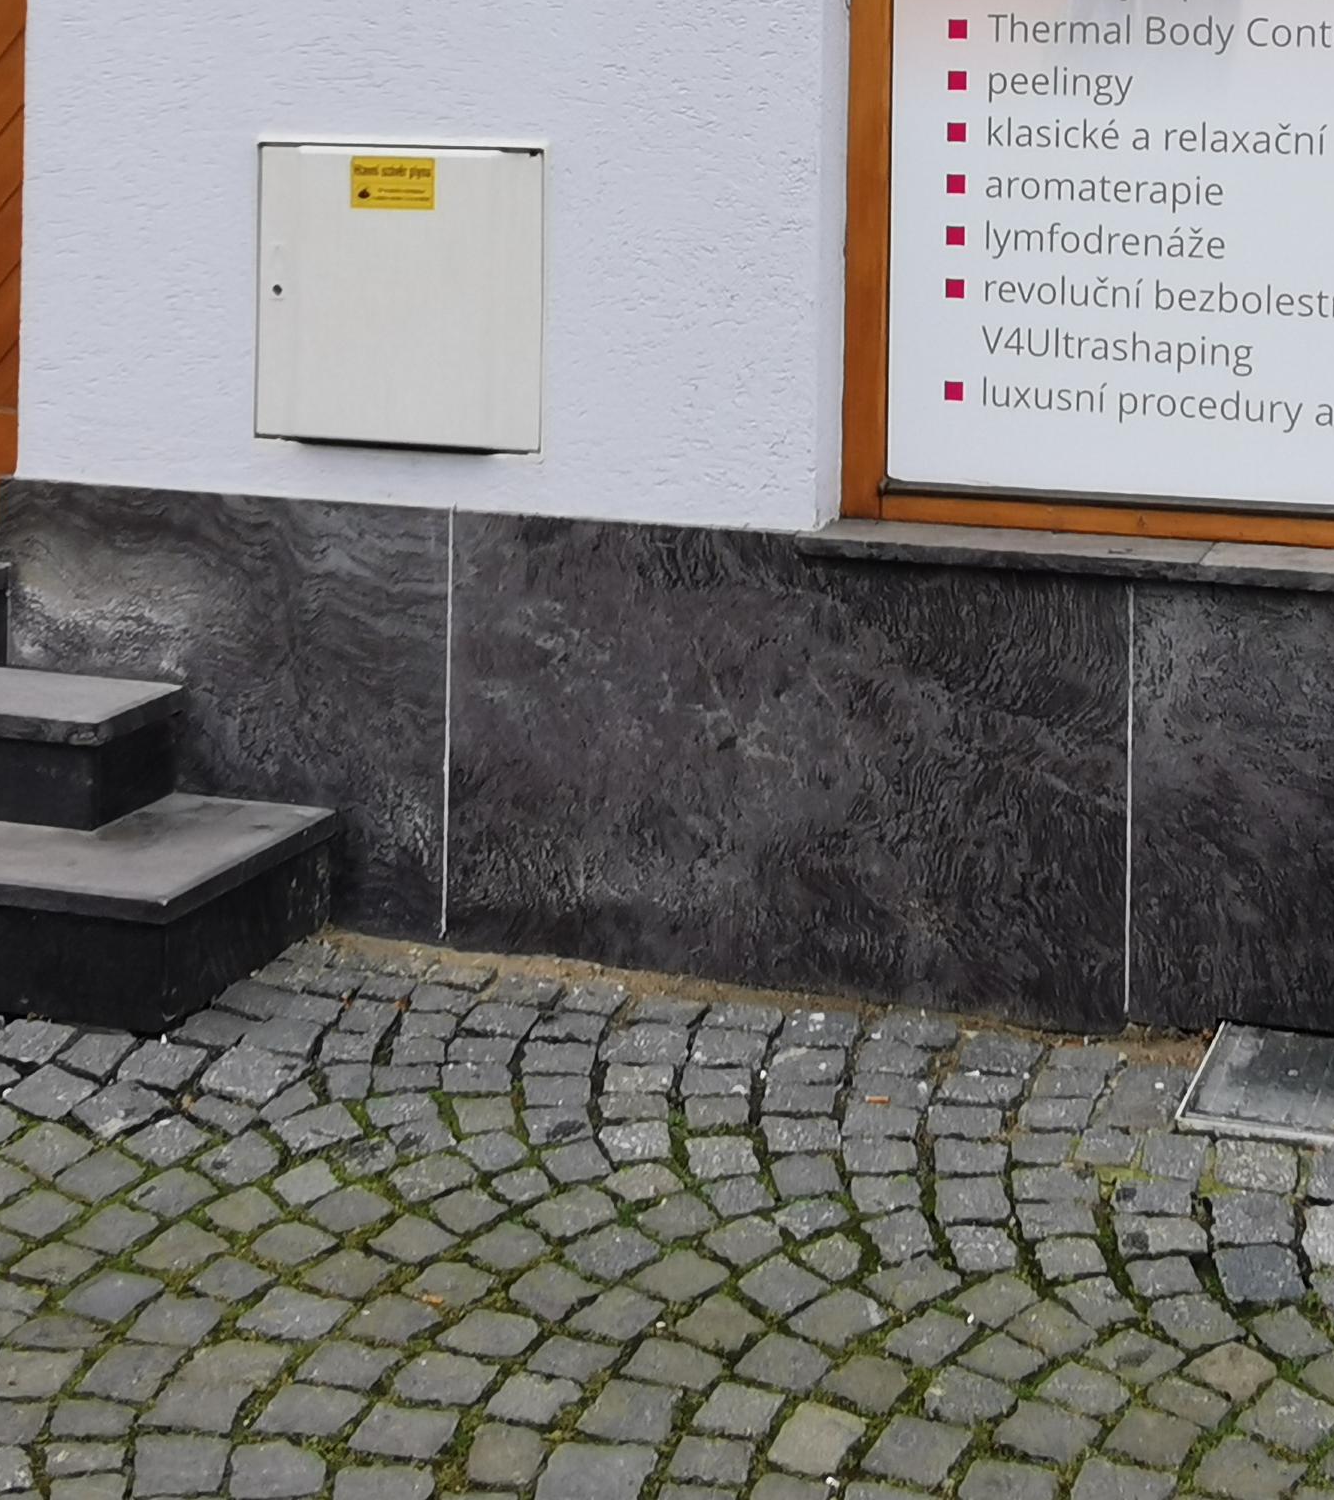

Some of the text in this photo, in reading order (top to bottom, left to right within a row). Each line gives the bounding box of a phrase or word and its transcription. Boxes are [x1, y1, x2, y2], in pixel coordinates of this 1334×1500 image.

[987, 13, 1131, 46] Thermal
[1146, 16, 1235, 54] Body
[987, 67, 1134, 106] peelingy
[987, 117, 1120, 151] klasické
[1131, 129, 1150, 151] a
[1164, 123, 1327, 157] relaxační
[985, 173, 1225, 212] aromaterapie
[984, 221, 1226, 261] lymfodrenáže
[984, 274, 1143, 310] revoluční
[981, 325, 1253, 377] V4Ultrashaping
[981, 377, 1105, 414] luxusní
[1119, 386, 1303, 434] procedury
[1315, 403, 1334, 428] a
